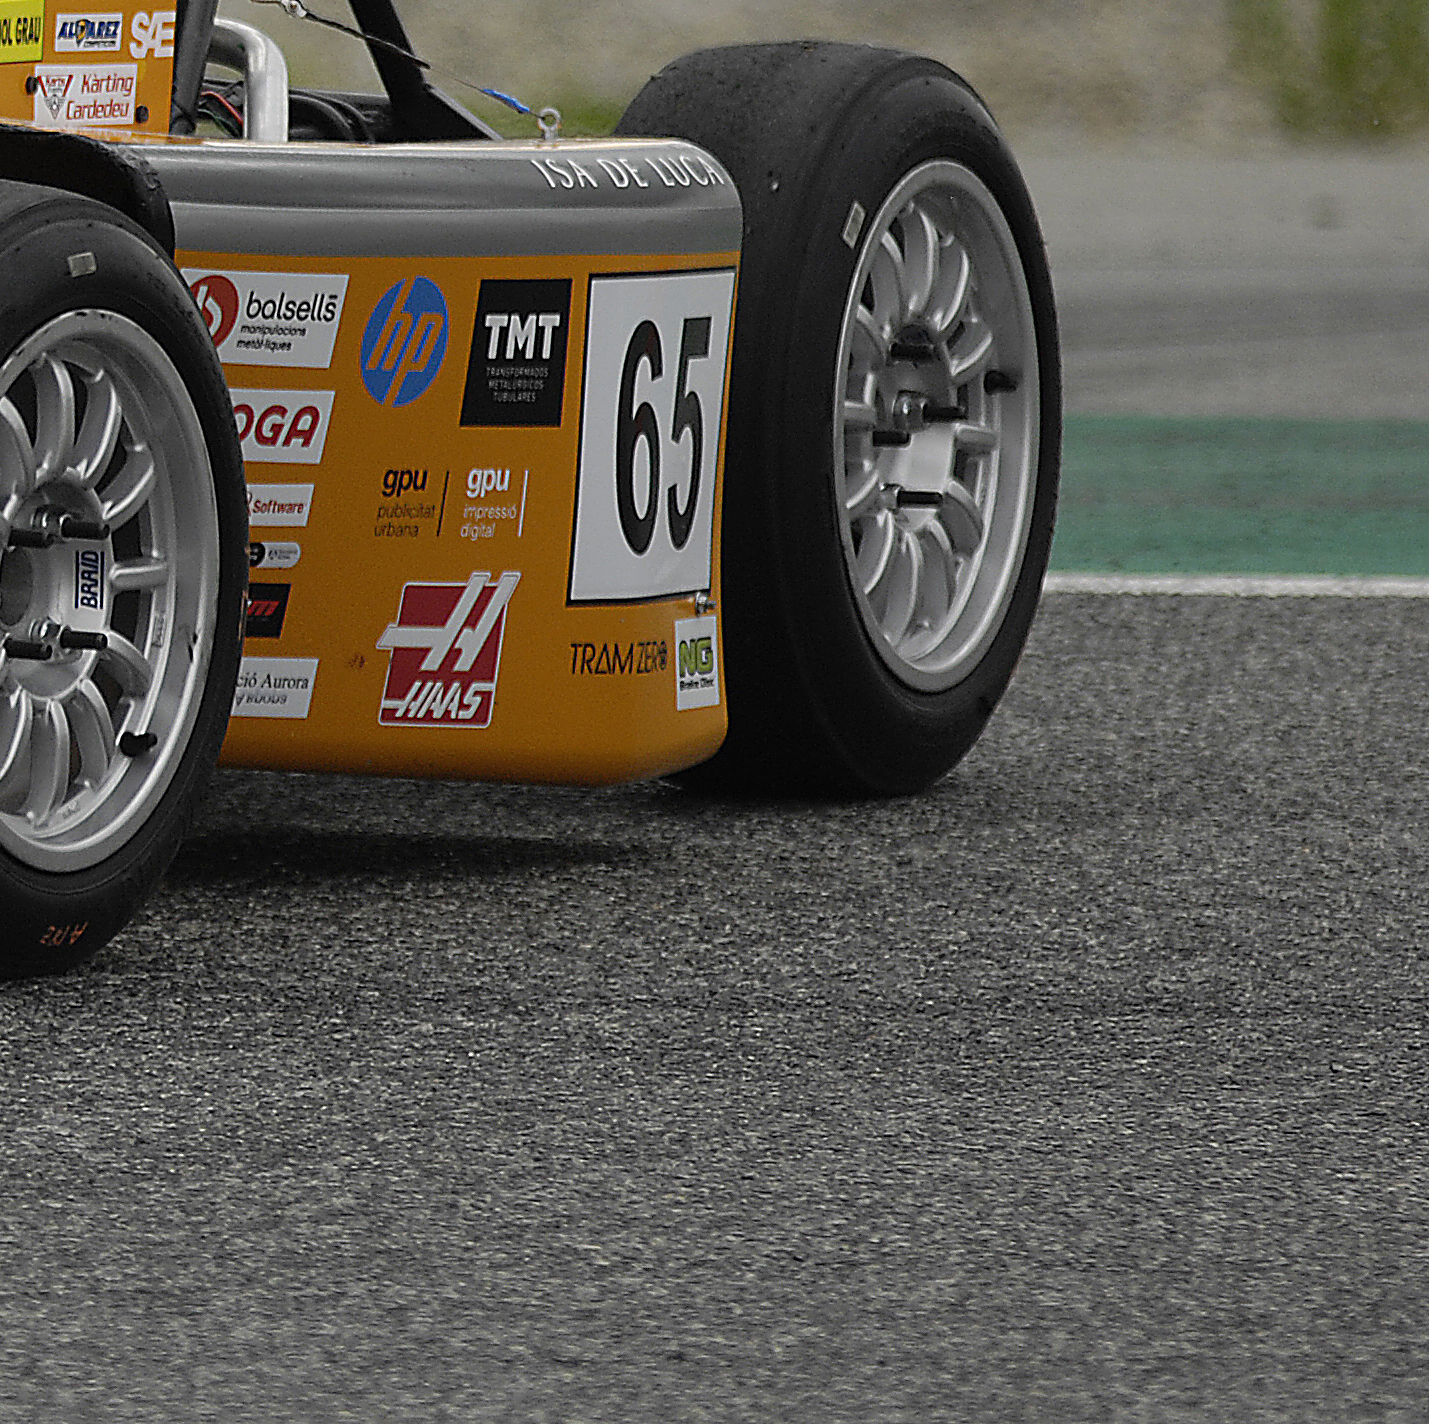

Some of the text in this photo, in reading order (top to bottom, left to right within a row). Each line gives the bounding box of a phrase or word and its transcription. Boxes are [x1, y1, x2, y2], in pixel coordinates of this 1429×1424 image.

[15, 17, 41, 46] GRAU
[81, 73, 133, 96] Kàrting
[66, 99, 129, 120] Cardedeu
[531, 155, 725, 188] ISA DE LUCA
[241, 325, 306, 337] manipulacions
[485, 313, 561, 360] TMT
[616, 316, 712, 556] 65
[382, 469, 428, 497] gpu
[466, 468, 510, 498] gpu
[252, 499, 304, 514] Software
[377, 504, 435, 519] publicitat
[463, 504, 517, 520] impressió
[374, 525, 419, 537] urbana
[460, 523, 495, 541] digital
[81, 550, 99, 609] BRAID
[679, 637, 714, 678] NG
[261, 673, 309, 689] Aurora
[382, 681, 494, 719] HAAS
